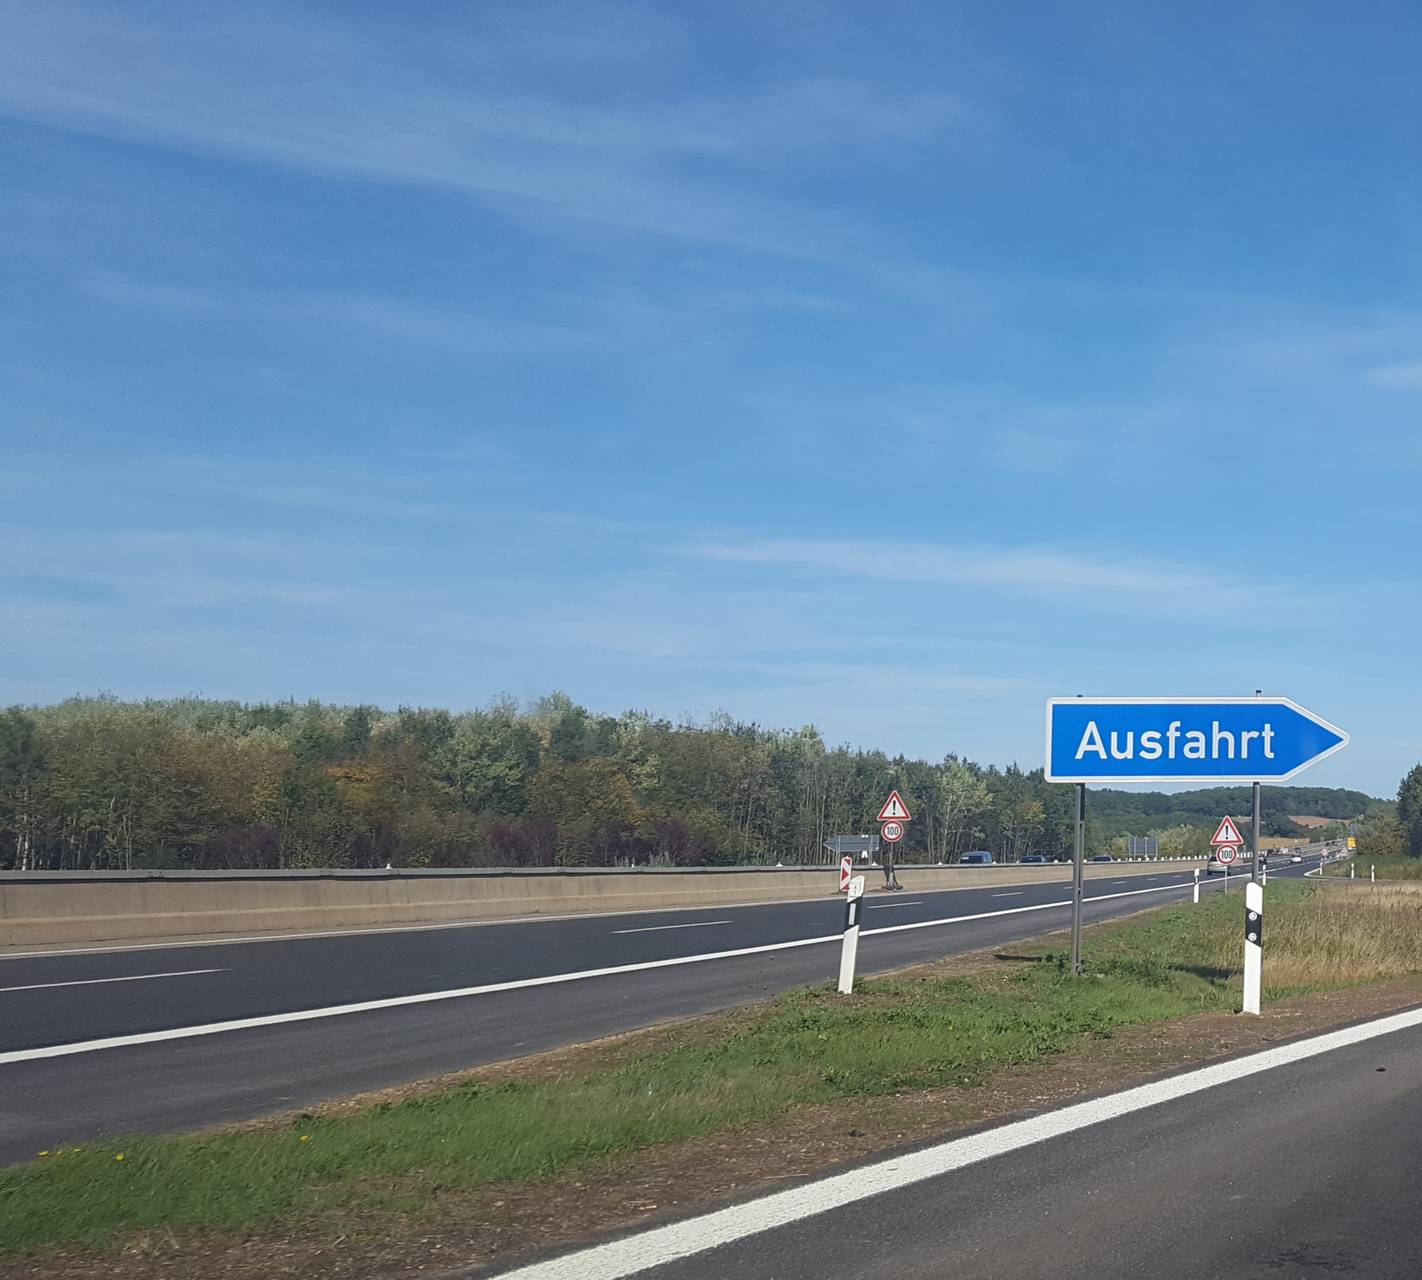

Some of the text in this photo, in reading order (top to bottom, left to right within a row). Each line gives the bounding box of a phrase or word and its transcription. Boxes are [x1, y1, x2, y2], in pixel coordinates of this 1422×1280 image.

[1074, 720, 1275, 760] Ausfahrt
[886, 826, 899, 836] 100
[1221, 850, 1233, 860] 100
